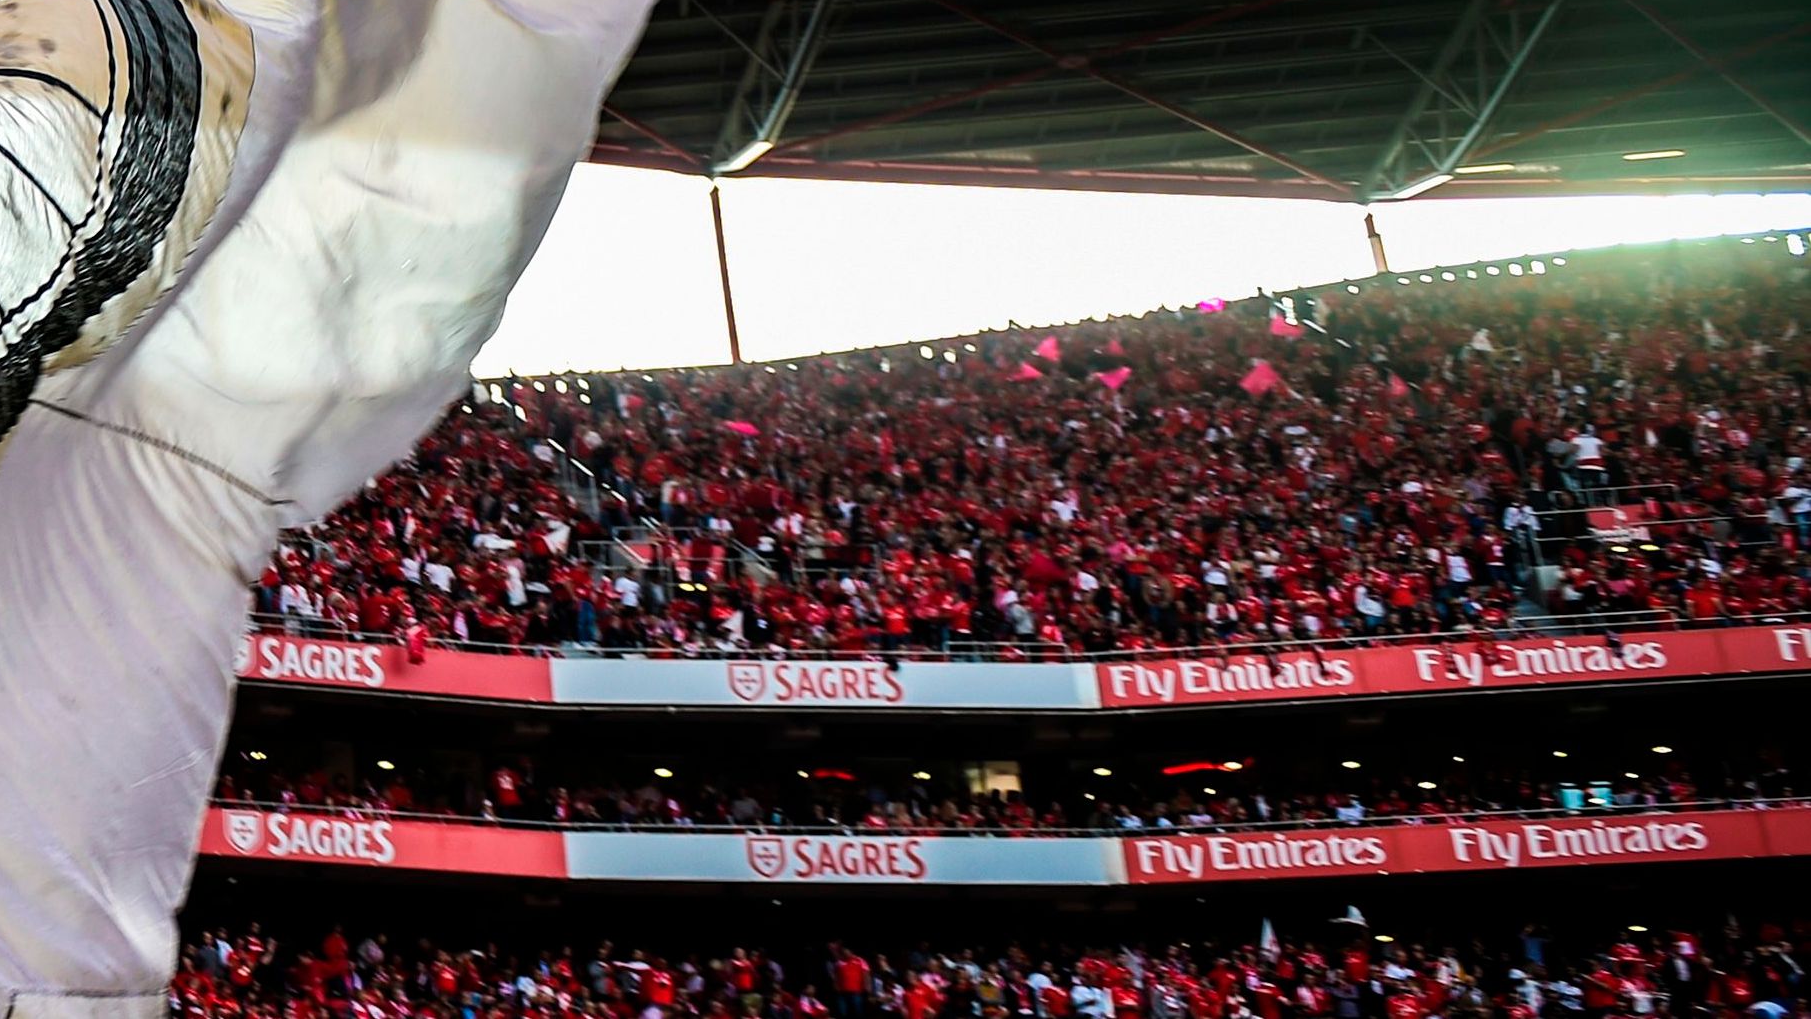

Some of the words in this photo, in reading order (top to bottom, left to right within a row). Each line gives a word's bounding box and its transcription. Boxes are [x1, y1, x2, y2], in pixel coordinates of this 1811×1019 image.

[260, 637, 385, 687] SAGRES
[774, 664, 903, 703] SAGRES
[1108, 664, 1175, 702] Fly
[1178, 657, 1354, 693] Emirates
[267, 813, 395, 863] SAGRES
[794, 839, 927, 879] SAGRES
[1135, 839, 1203, 878] Fly
[1205, 833, 1387, 871] Emirates
[1448, 827, 1519, 867] Fly
[1522, 820, 1707, 858] Emirates
